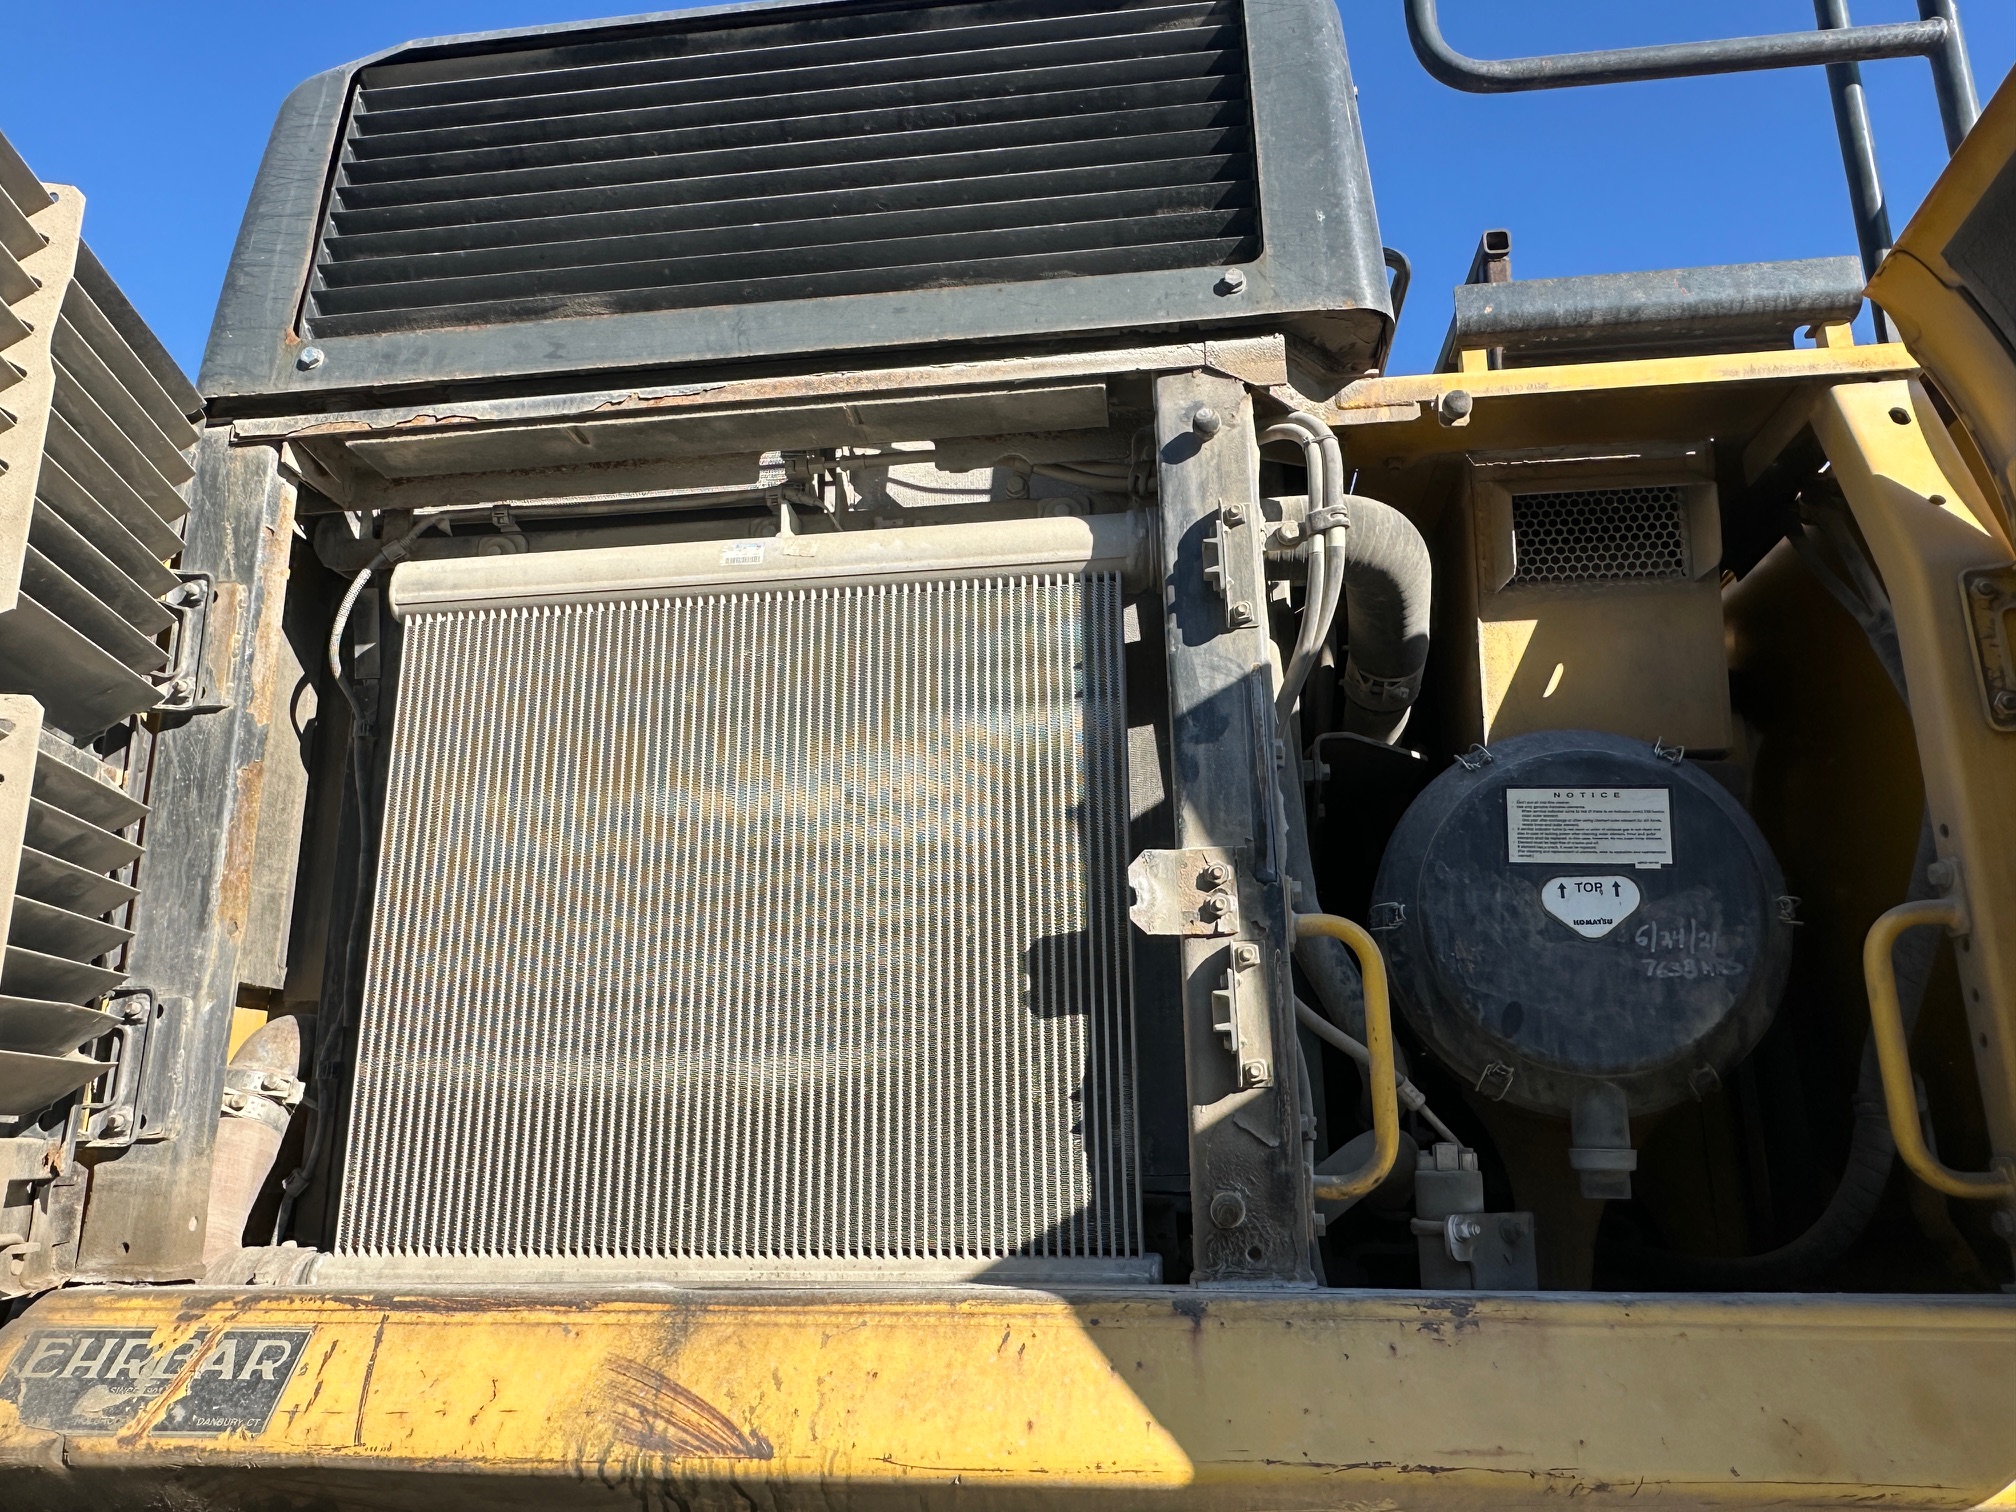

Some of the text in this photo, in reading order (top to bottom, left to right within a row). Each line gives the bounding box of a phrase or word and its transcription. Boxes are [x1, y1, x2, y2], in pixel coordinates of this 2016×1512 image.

[1573, 917, 1613, 926] KOMATSU
[16, 1337, 291, 1380] EHRBAR
[195, 1417, 243, 1427] DANBURY
